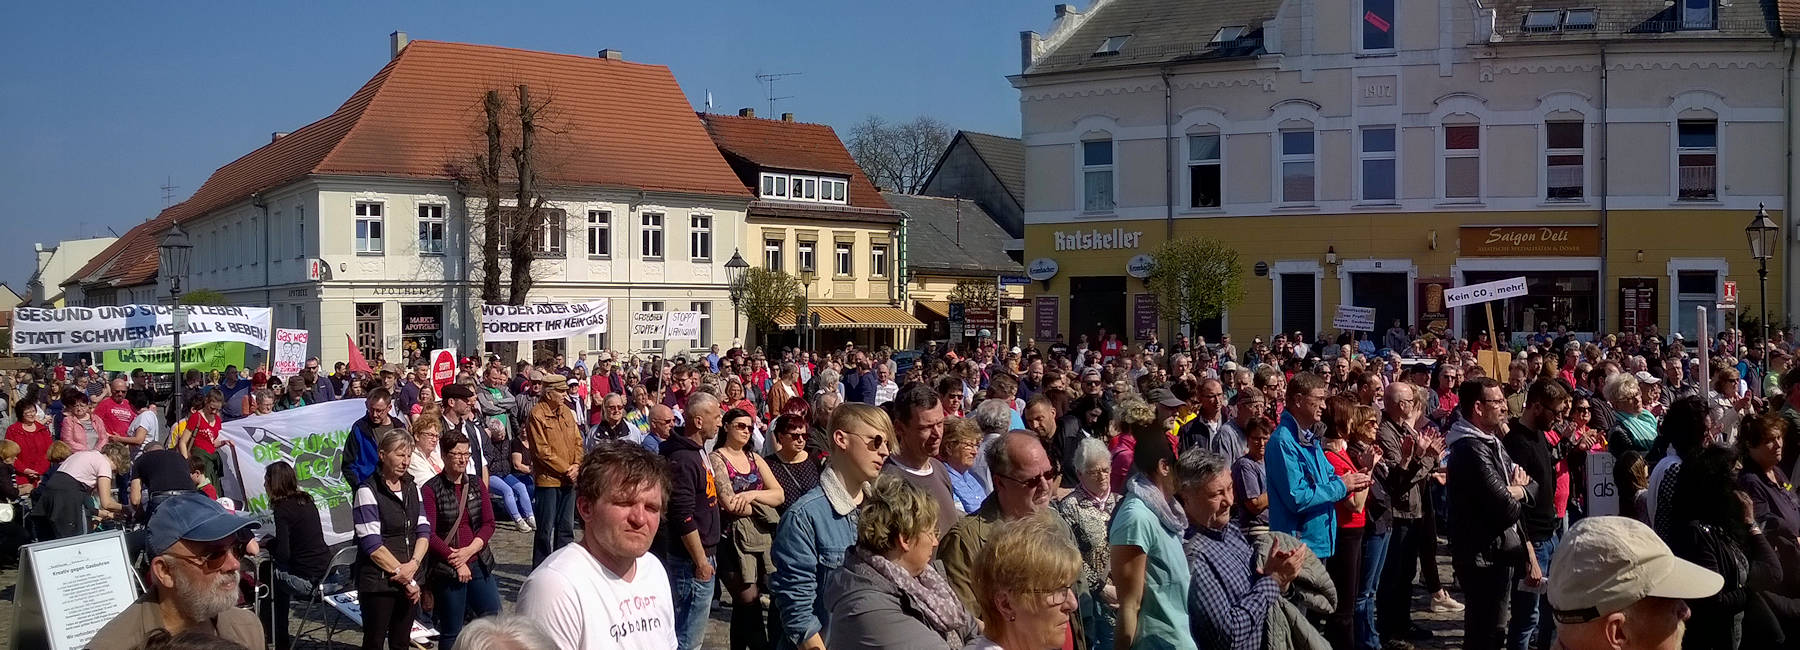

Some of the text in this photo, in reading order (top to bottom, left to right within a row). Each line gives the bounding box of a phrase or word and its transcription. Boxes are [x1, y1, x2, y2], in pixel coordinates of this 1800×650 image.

[1054, 228, 1143, 251] Ratskeller
[1485, 227, 1568, 246] Saigon Deli
[372, 287, 433, 296] APOTHEKE
[1447, 292, 1470, 302] Kein
[1497, 282, 1525, 294] mehr!
[16, 307, 92, 322] GESUND
[98, 305, 136, 320] UND
[200, 305, 249, 320] LEBEN,
[482, 304, 505, 316] WO
[508, 304, 533, 316] DER
[536, 303, 569, 316] ADLER
[14, 321, 268, 345] STATT SCHWERMEALL & BEBEN!
[481, 318, 542, 334] FÖRDERT
[545, 319, 562, 331] IHR
[563, 316, 584, 329] KEIN
[277, 329, 309, 344] Gas weg
[252, 427, 352, 463] DIE ZUKUN
[296, 456, 335, 481] IEGT
[52, 568, 70, 576] Kreativ
[70, 565, 85, 574] gegen
